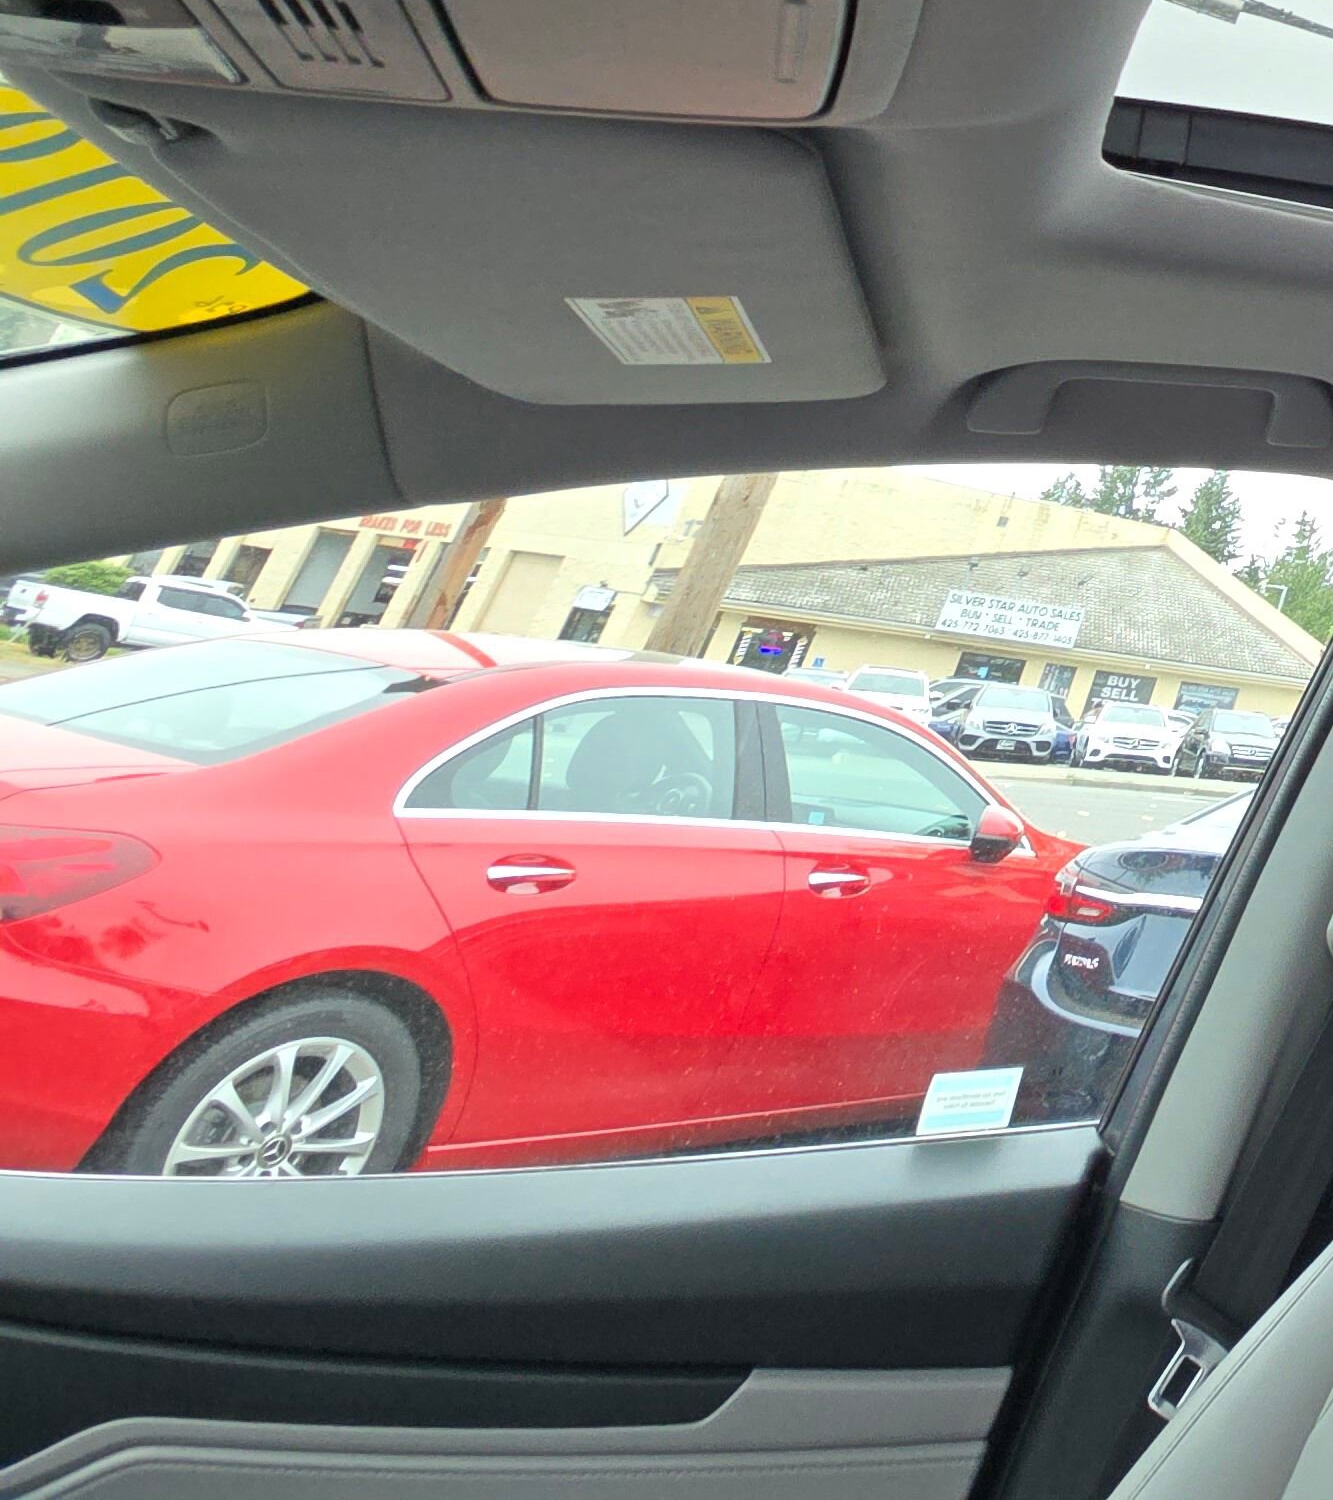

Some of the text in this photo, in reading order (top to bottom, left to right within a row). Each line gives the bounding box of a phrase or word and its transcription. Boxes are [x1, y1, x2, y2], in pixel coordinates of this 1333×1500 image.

[950, 593, 1082, 622] SILVER STAR AUTO SALES
[960, 608, 1061, 632] BUY SELL TRADE
[1107, 675, 1141, 688] BUY
[1100, 686, 1139, 702] SELL
